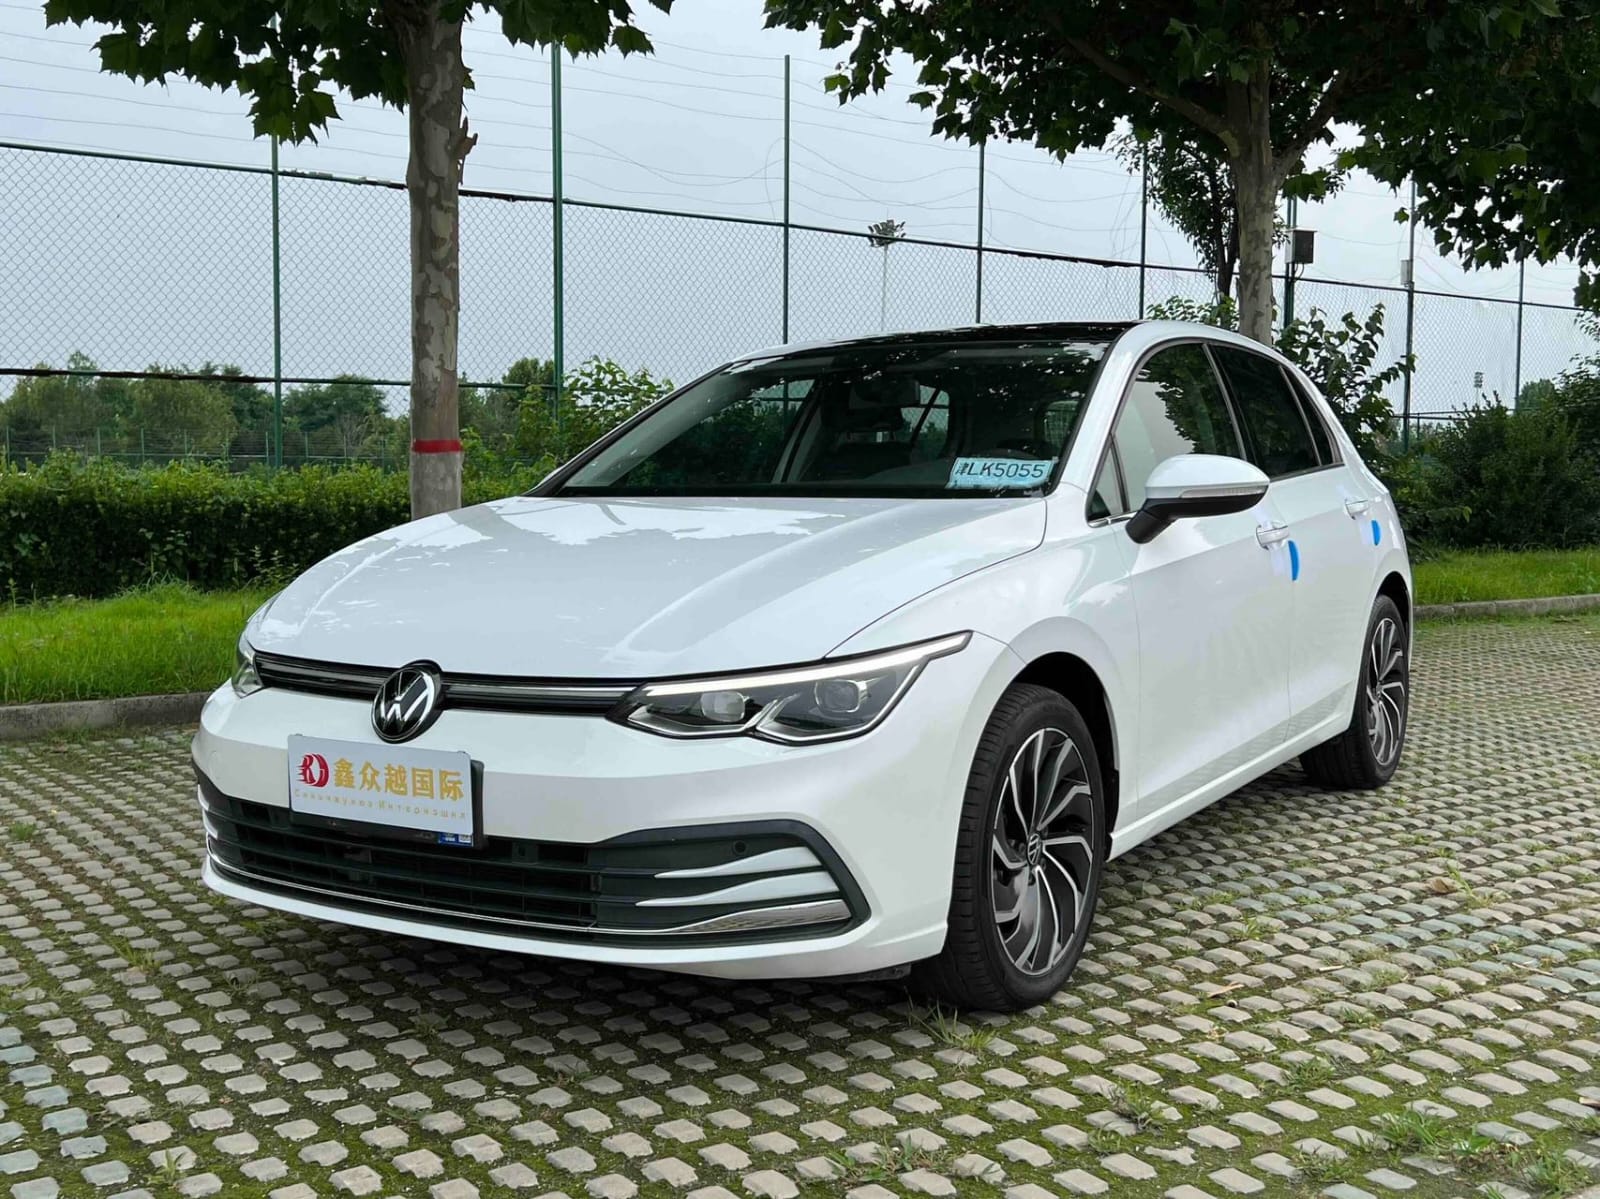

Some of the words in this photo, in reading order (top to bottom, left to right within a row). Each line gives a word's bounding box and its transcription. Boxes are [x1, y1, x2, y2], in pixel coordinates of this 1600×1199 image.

[334, 758, 464, 801] 鑫众越国际
